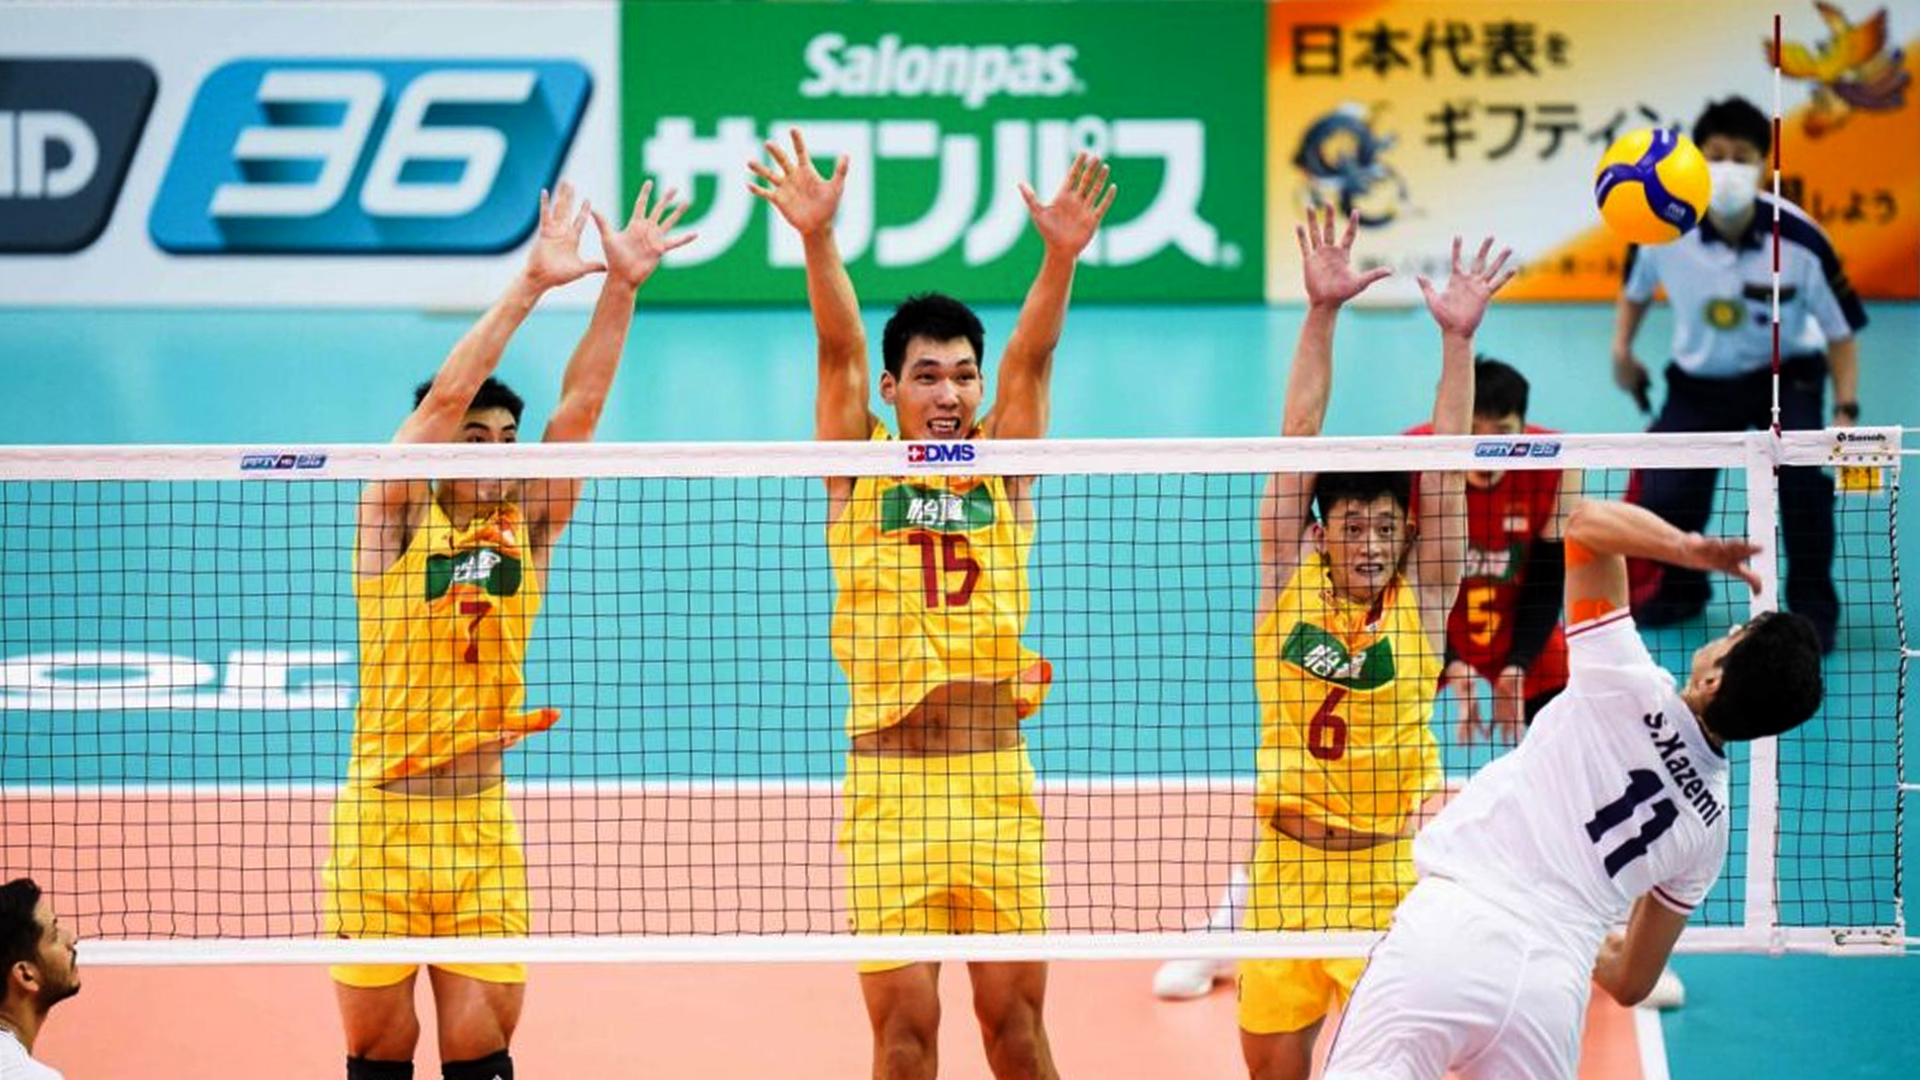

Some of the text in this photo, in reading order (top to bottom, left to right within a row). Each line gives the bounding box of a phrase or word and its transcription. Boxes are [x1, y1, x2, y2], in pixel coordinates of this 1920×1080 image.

[800, 33, 1078, 109] Salonpas
[1291, 20, 1571, 78] 日本代表を
[208, 69, 537, 217] 36
[642, 114, 1219, 267] サロンパス
[925, 443, 975, 462] DMS
[908, 532, 980, 609] 15
[460, 600, 493, 664] 7
[1467, 587, 1501, 646] 5
[1308, 686, 1348, 761] 6
[1643, 711, 1726, 828] S.Kazemi
[1585, 768, 1680, 879] 11
